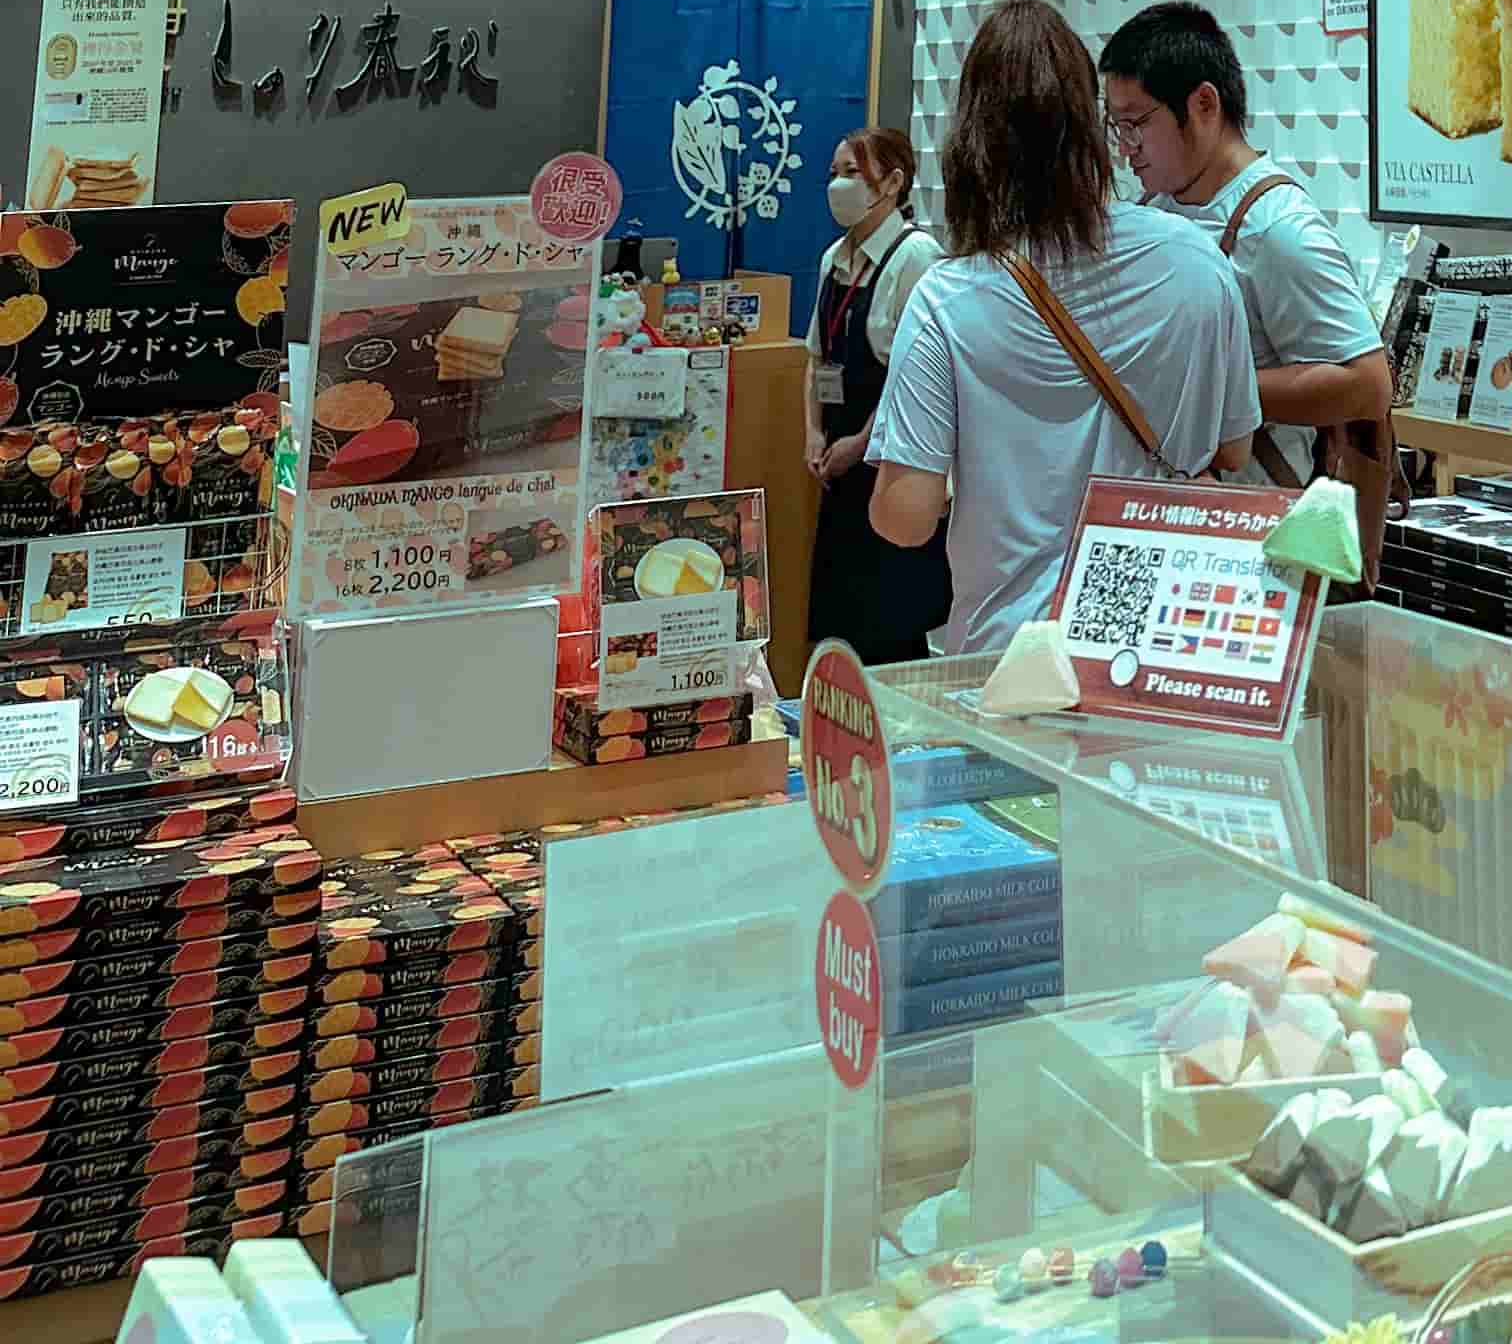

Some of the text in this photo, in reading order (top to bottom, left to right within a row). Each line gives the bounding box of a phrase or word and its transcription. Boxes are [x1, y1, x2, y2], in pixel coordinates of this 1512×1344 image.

[551, 166, 609, 197] 很受
[1409, 161, 1474, 185] CASTELLA
[328, 196, 406, 245] NEW
[338, 247, 426, 272] マンゴー
[401, 486, 454, 507] MANGO
[457, 482, 502, 501] langue
[506, 478, 522, 494] de
[527, 476, 556, 492] chat
[373, 544, 451, 570] 1,100円
[1169, 549, 1202, 570] QR
[368, 569, 450, 595] 2,200円
[1144, 672, 1272, 707] Please scan it.
[813, 675, 873, 740] RANKING
[928, 885, 993, 910] HOKKAIDO
[995, 880, 1026, 898] MILK
[823, 920, 872, 1003] Must
[933, 937, 999, 962] HOKKAIDO
[1000, 932, 1030, 955] MILK
[931, 990, 996, 1015] HOKKAIDO
[999, 983, 1023, 1003] MILK
[829, 991, 865, 1072] buy
